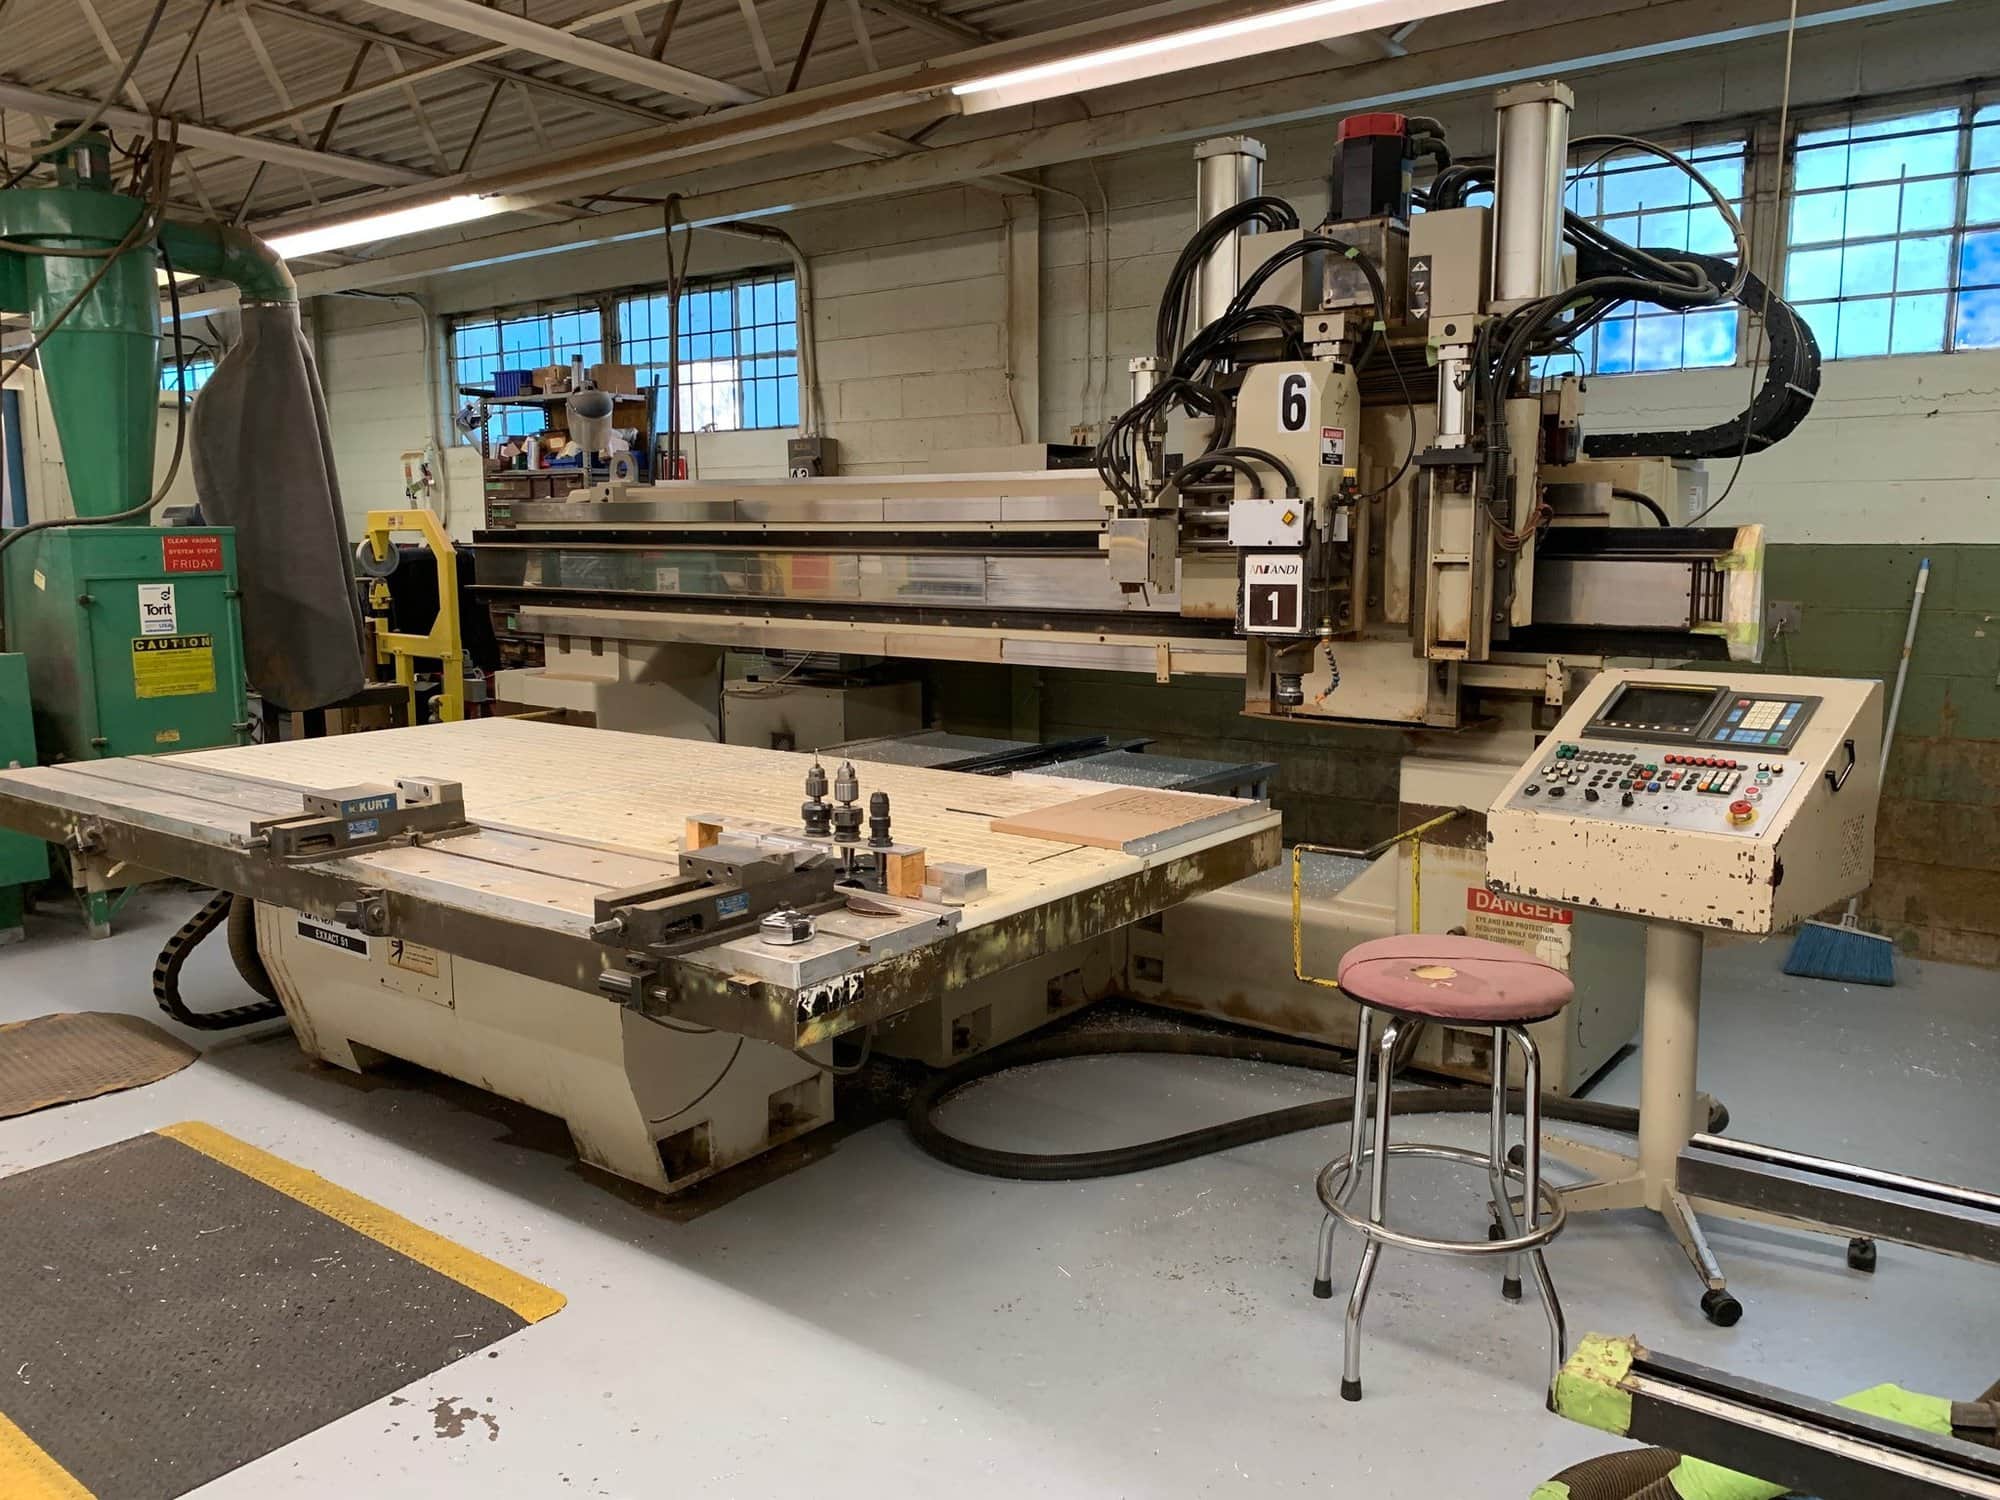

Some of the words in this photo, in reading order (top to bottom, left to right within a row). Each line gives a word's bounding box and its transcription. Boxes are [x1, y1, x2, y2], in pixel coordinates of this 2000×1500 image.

[1415, 281, 1425, 295] Z
[1282, 374, 1306, 431] 6
[172, 559, 215, 569] FRIDAY
[143, 603, 172, 616] Torit
[1267, 591, 1279, 621] 1
[135, 637, 210, 650] CAUTION
[359, 798, 390, 812] KURT
[1476, 892, 1564, 920] DANGER
[1515, 921, 1555, 934] PROTECTION
[315, 929, 339, 945] EXXACT
